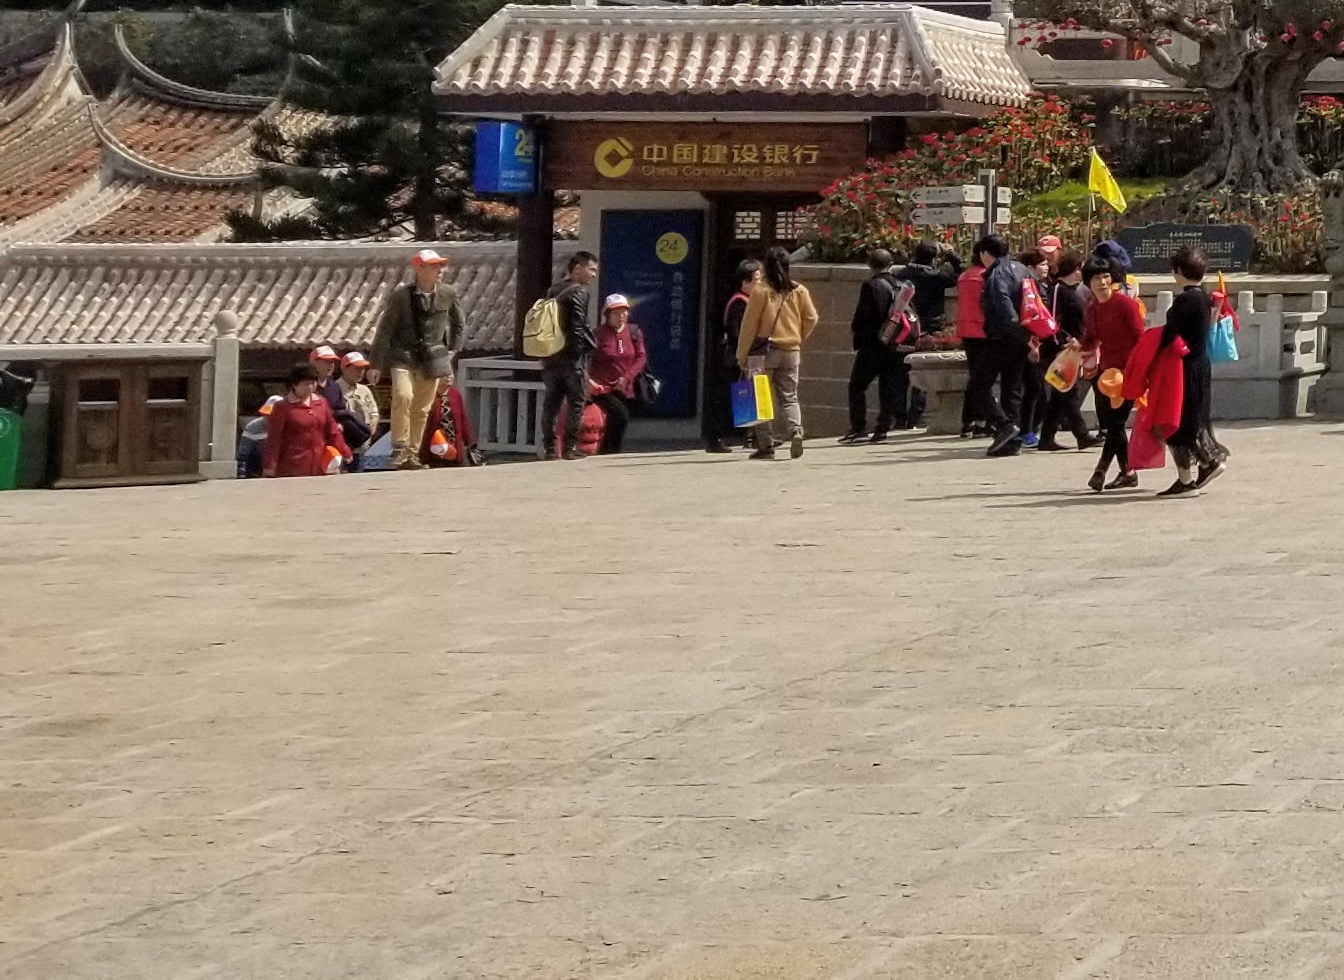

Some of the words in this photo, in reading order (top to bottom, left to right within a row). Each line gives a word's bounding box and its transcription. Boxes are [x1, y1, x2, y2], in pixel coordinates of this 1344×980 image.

[642, 144, 820, 164] 中国建设银行
[642, 165, 678, 177] China
[682, 165, 760, 177] Construction
[763, 165, 796, 177] Bank
[659, 239, 678, 253] 24
